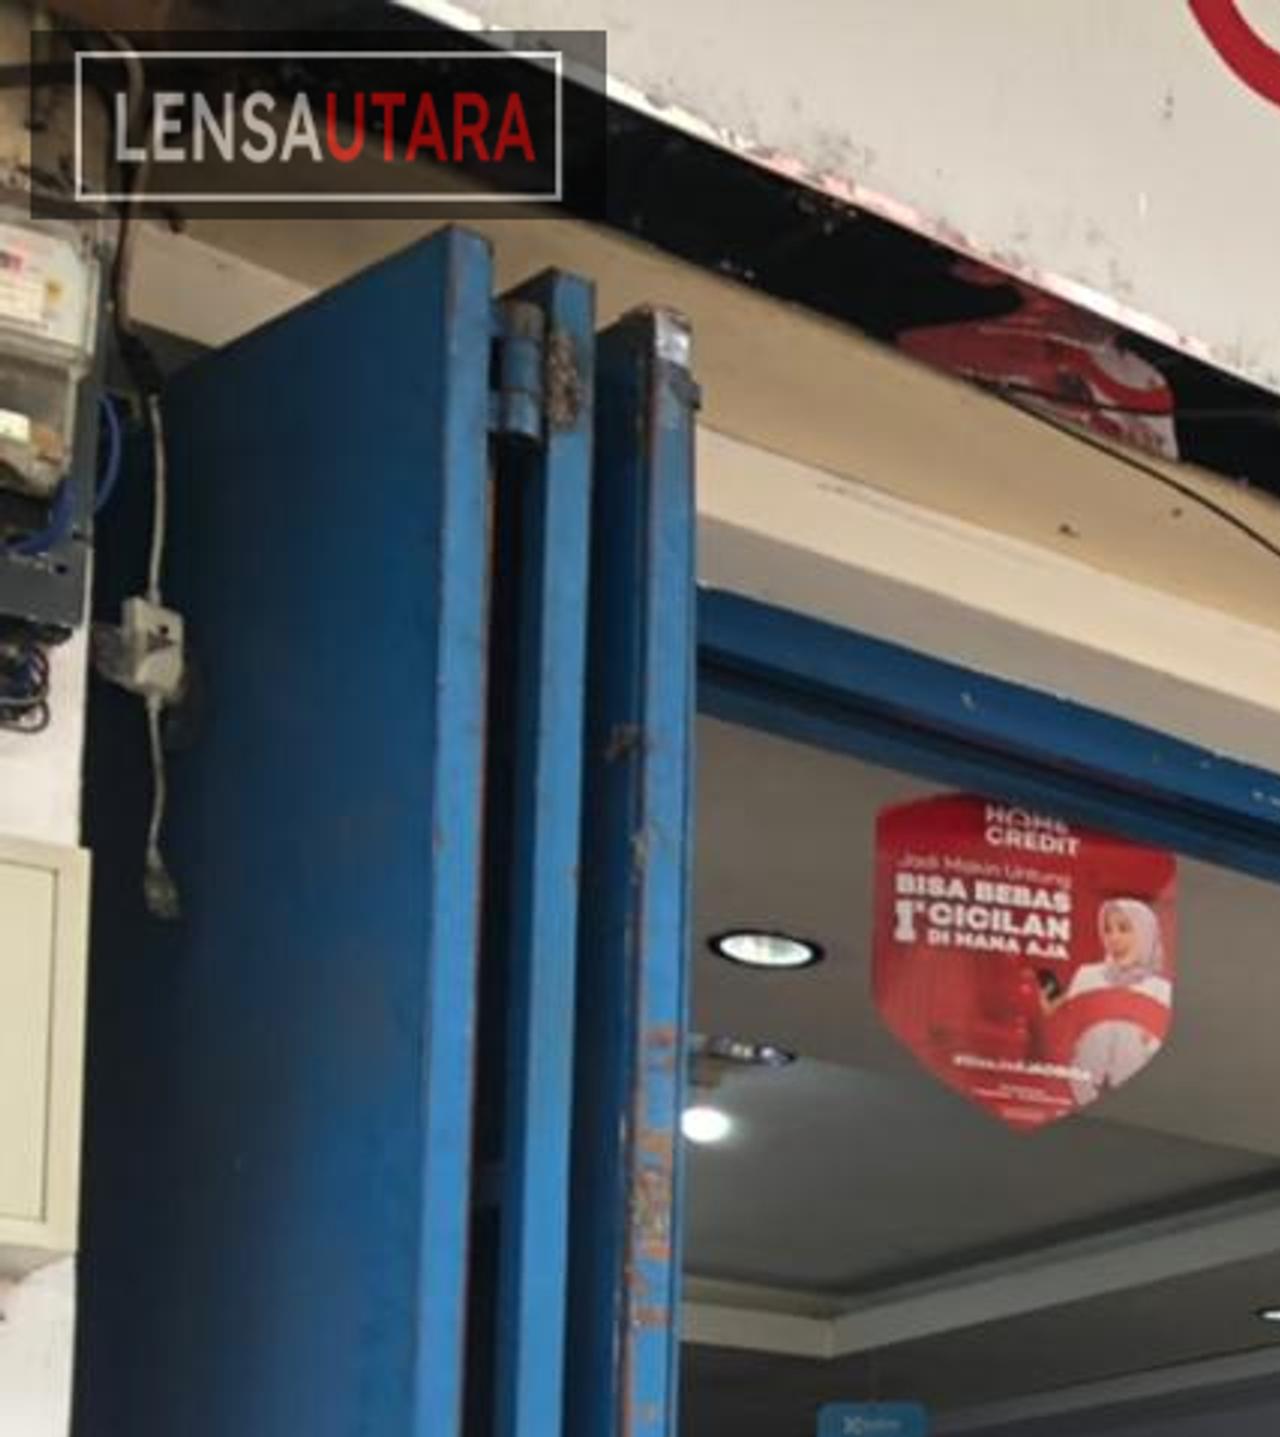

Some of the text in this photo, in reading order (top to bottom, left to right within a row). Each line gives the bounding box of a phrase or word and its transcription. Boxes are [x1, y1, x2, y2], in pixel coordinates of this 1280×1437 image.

[984, 826, 1080, 857] CREDIT
[896, 872, 1071, 914] BISA BEBAS
[929, 902, 1071, 942] CICILAN
[927, 928, 1070, 960] DI MANA AJA
